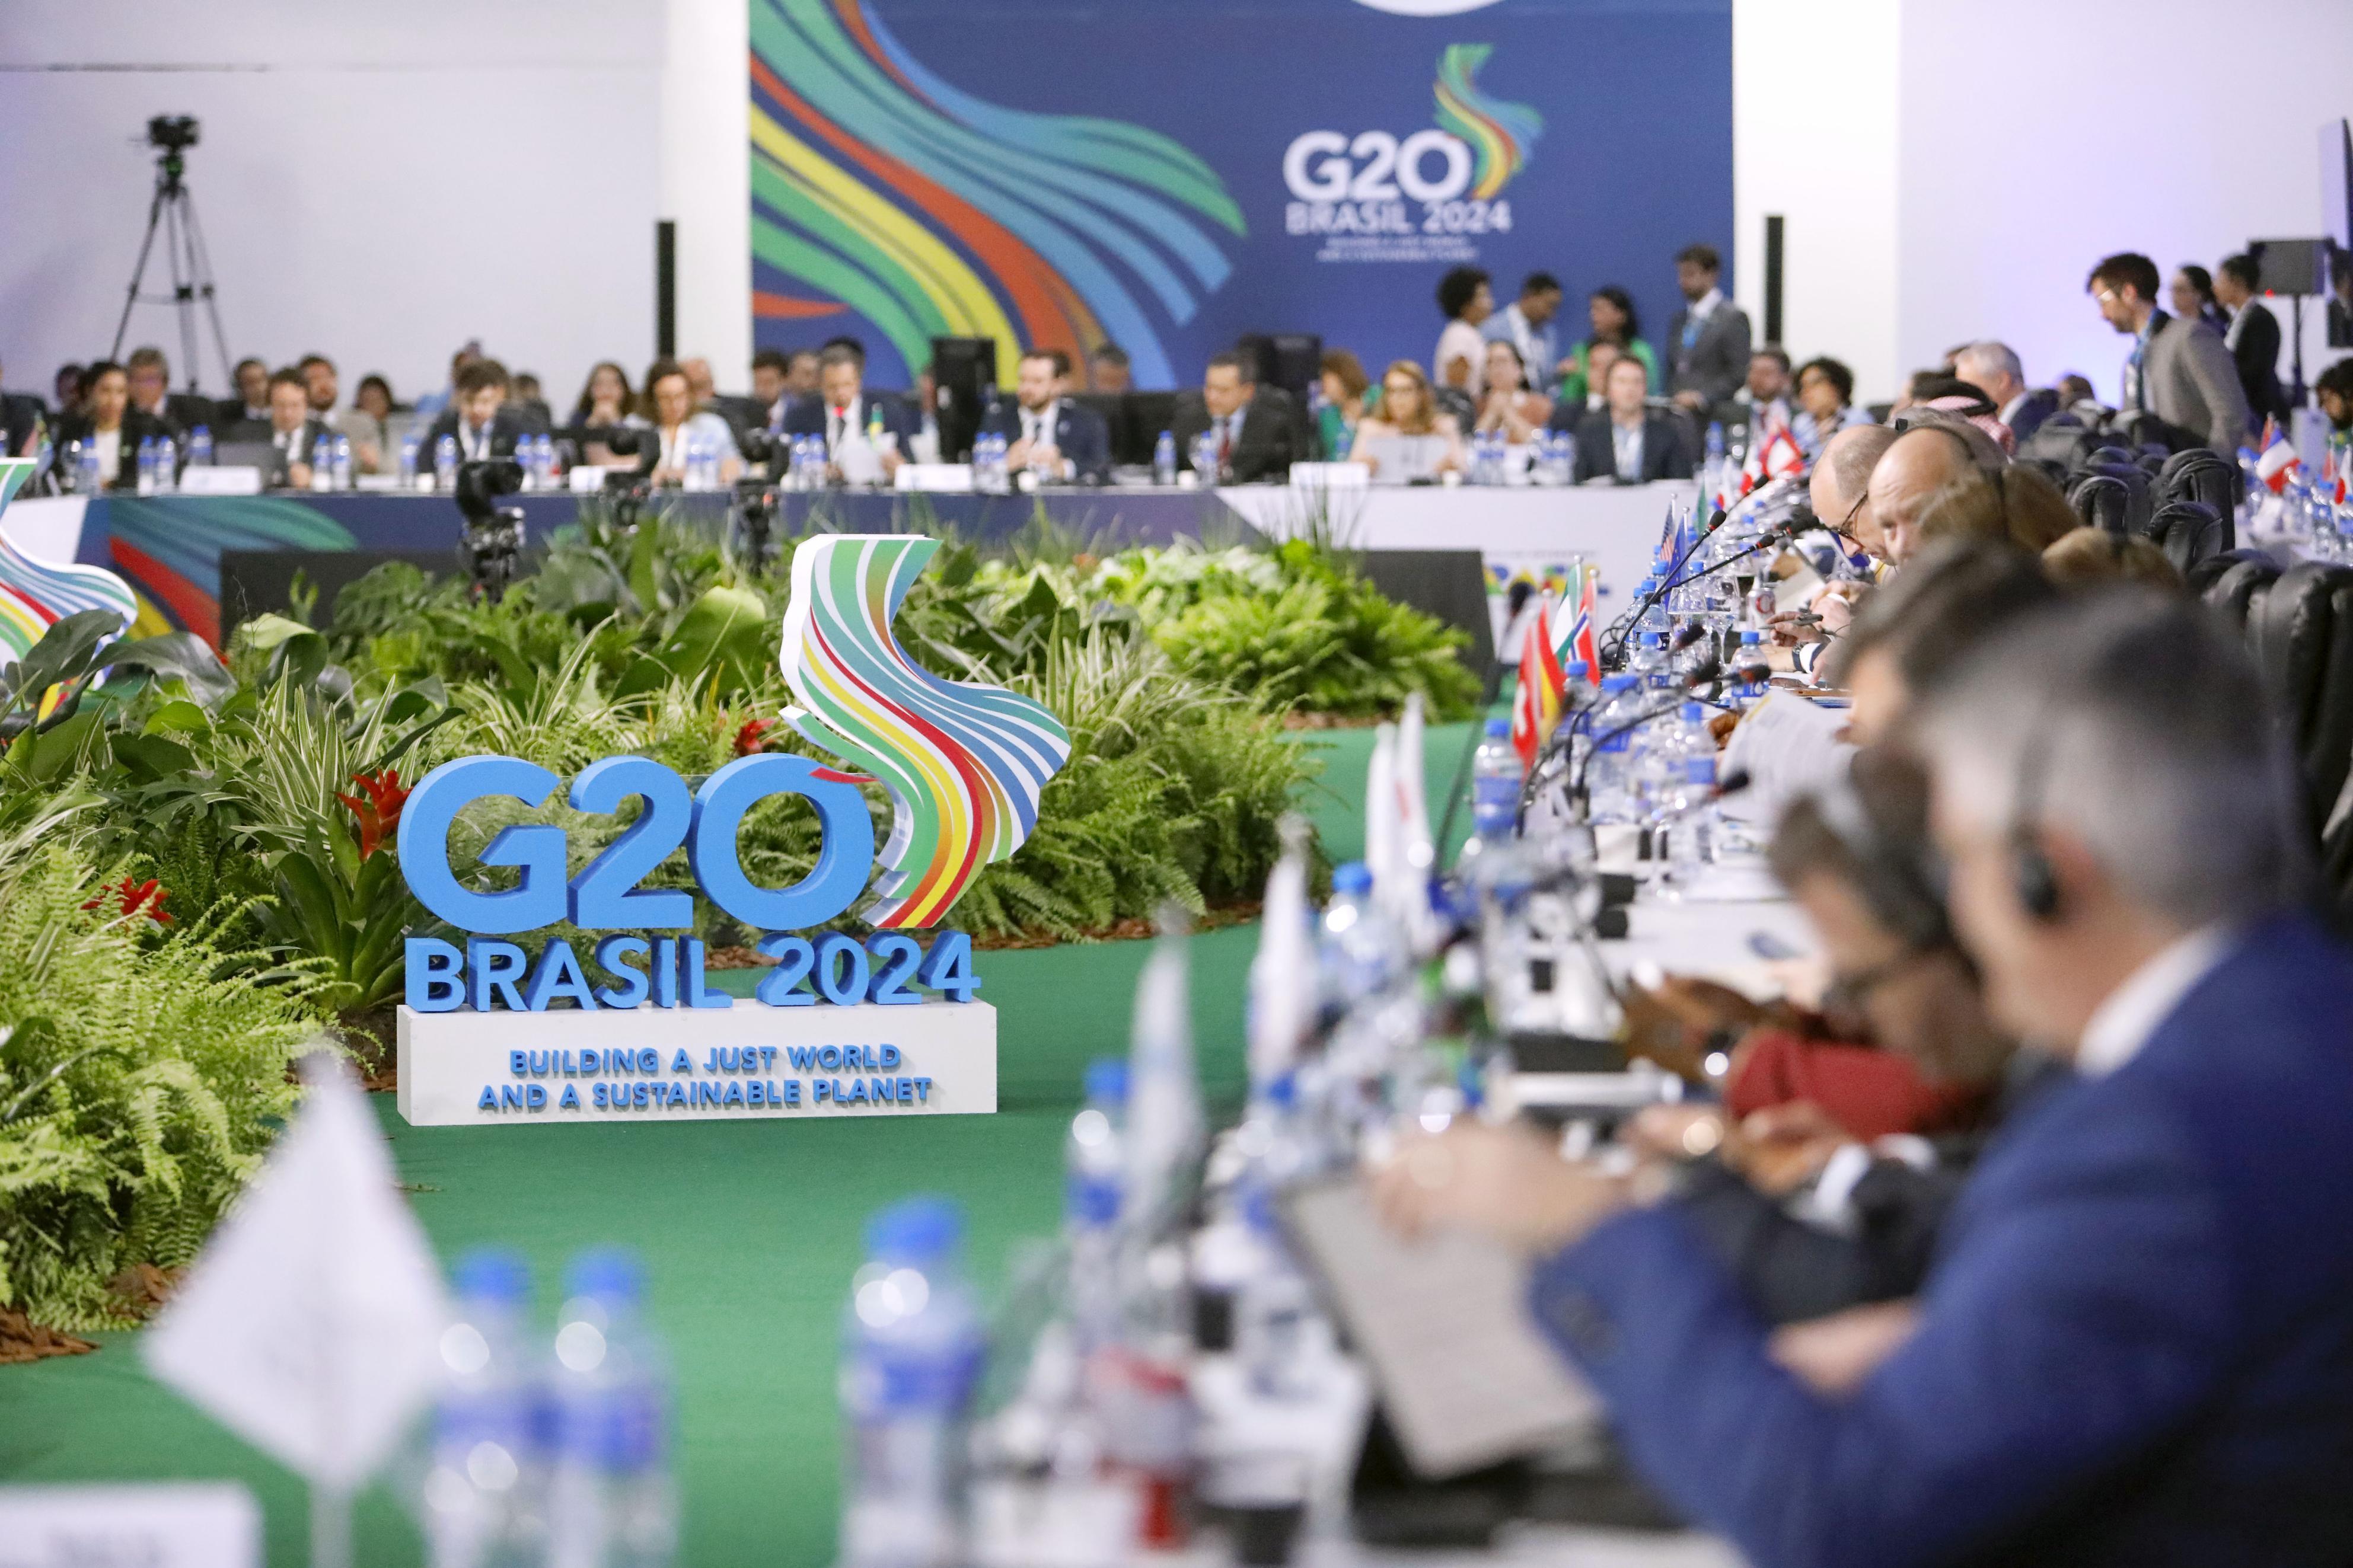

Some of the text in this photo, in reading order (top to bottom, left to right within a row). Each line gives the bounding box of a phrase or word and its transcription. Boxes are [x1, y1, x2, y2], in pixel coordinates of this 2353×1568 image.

[1283, 129, 1472, 202] G20
[1284, 200, 1512, 235] BRASIL 2024
[397, 752, 874, 933] G20
[405, 930, 981, 1012] BRASIL 2024
[510, 1043, 901, 1073] BUILDING A JUST WORLD
[477, 1077, 932, 1108] AND A SUSTAINABLE PLANET
